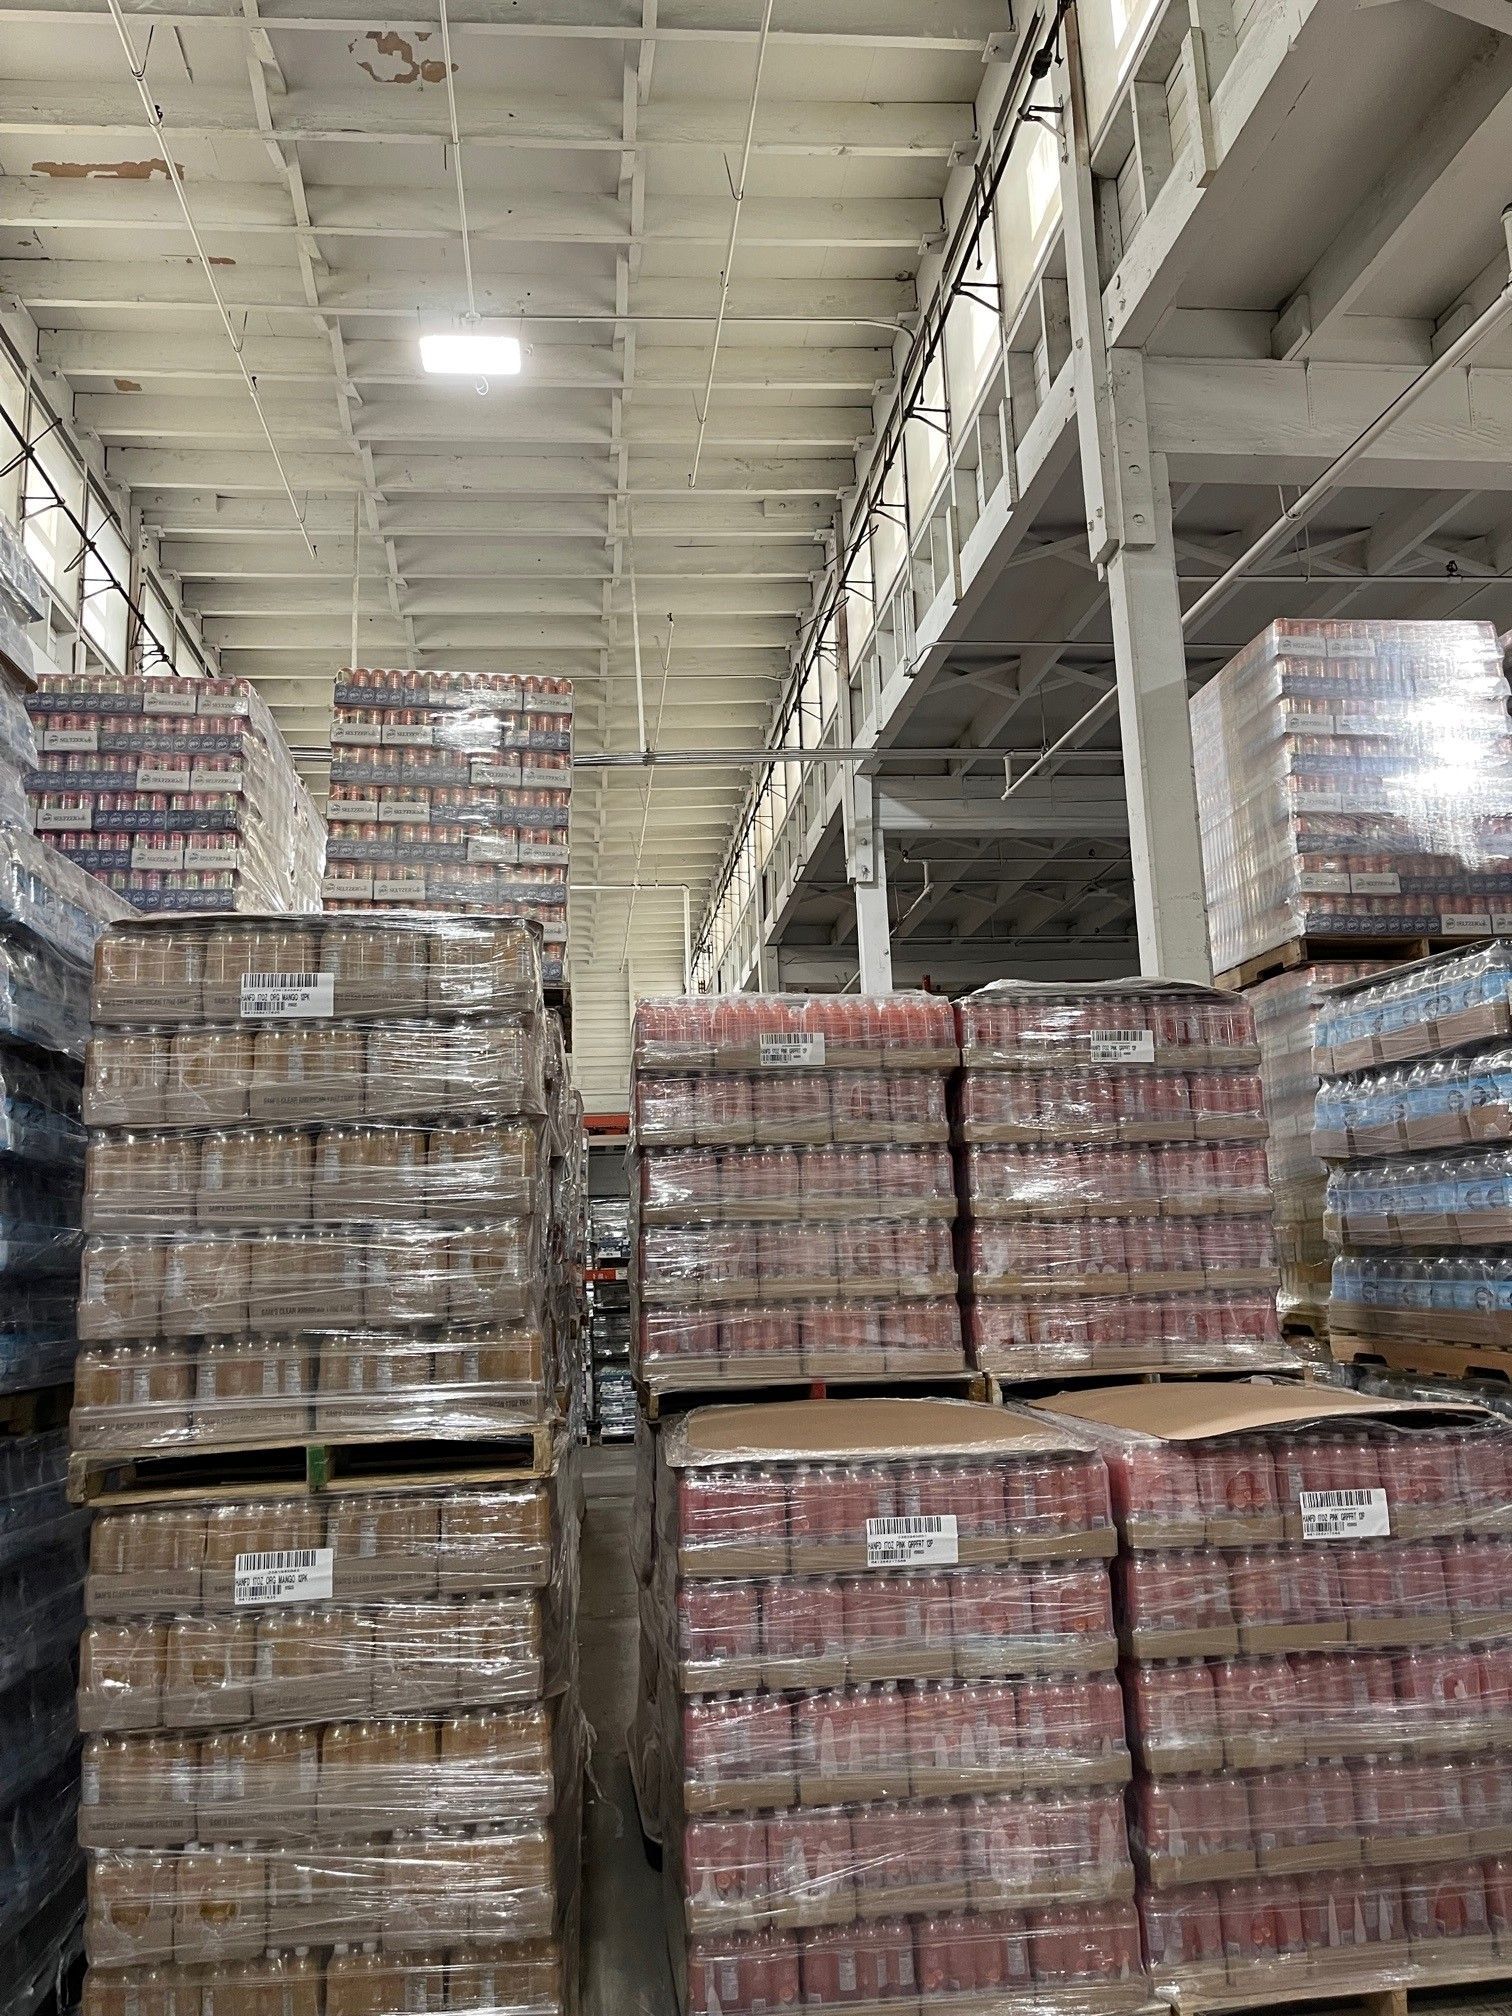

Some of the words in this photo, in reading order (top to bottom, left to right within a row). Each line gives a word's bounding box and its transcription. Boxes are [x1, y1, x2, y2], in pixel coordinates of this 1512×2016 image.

[270, 993, 280, 1001] ORG
[282, 993, 298, 1001] MANGO
[896, 1540, 905, 1549] PINK
[266, 1576, 276, 1584] ORG
[278, 1575, 295, 1584] MANGO
